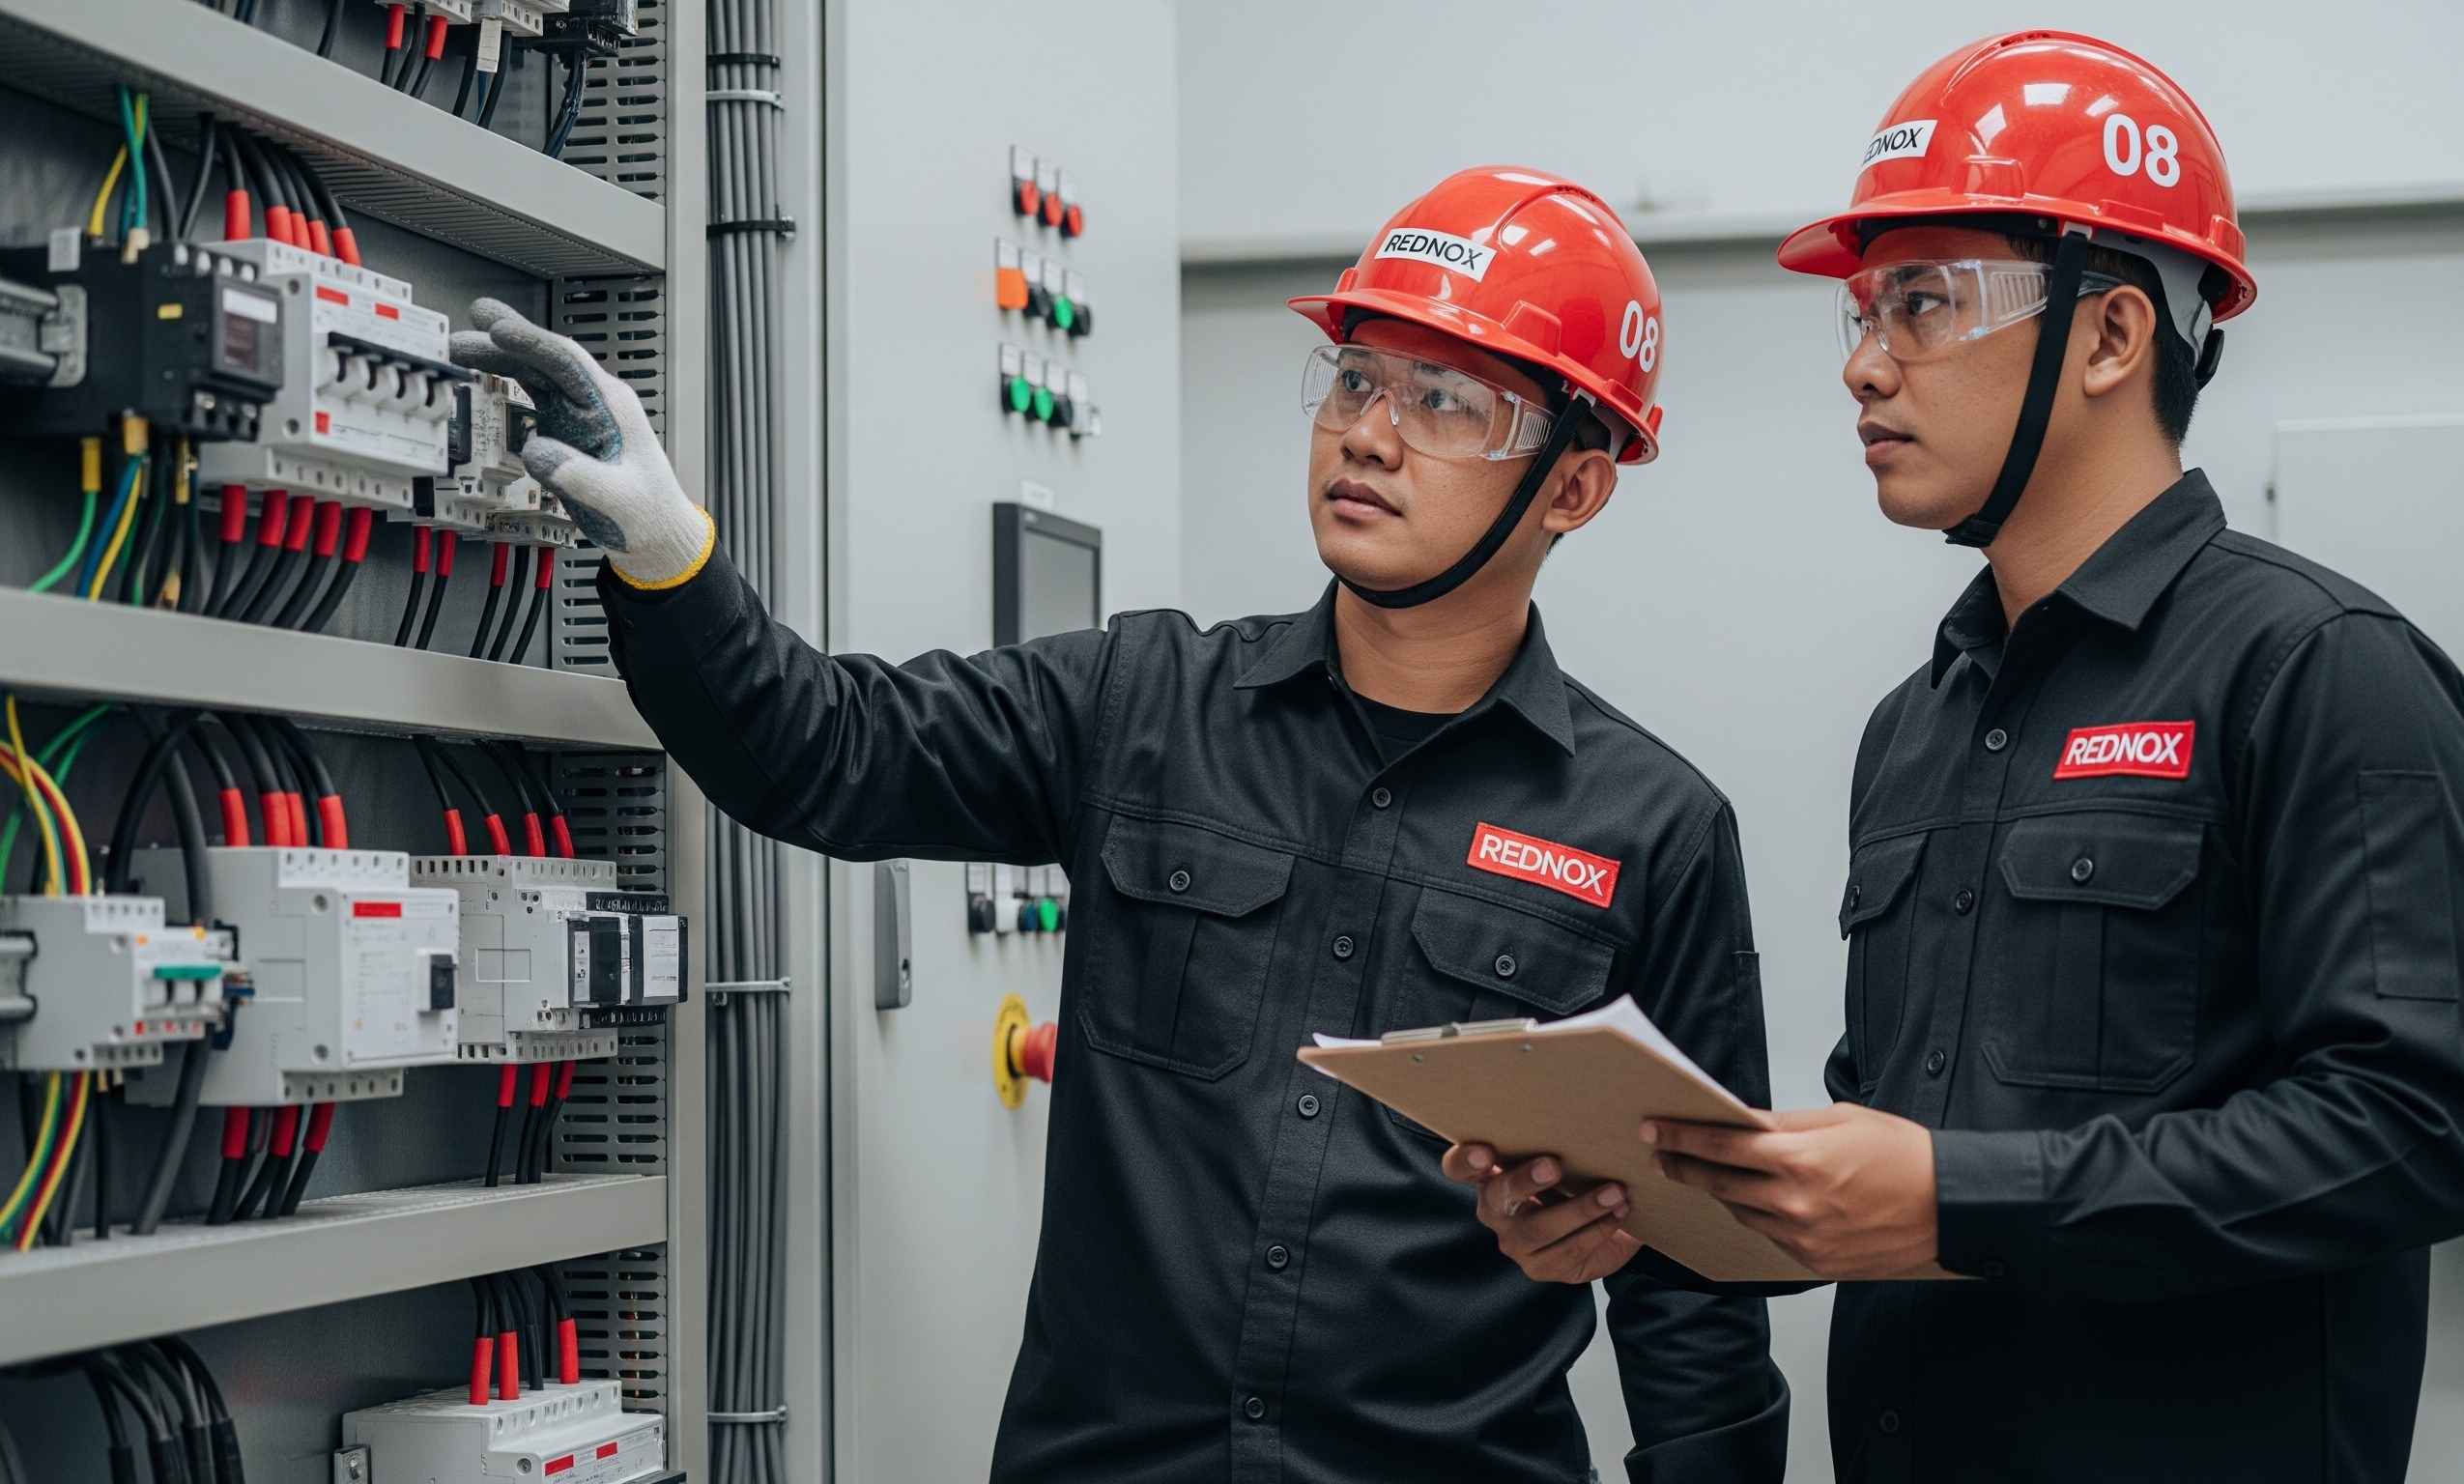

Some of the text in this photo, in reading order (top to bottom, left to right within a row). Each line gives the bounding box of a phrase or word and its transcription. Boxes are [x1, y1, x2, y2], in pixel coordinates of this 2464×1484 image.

[2104, 113, 2180, 187] 08
[1384, 234, 1482, 271] REDNOX
[1619, 300, 1659, 373] 08
[2064, 731, 2184, 766] REDNOX
[1478, 833, 1608, 898] REDNOX
